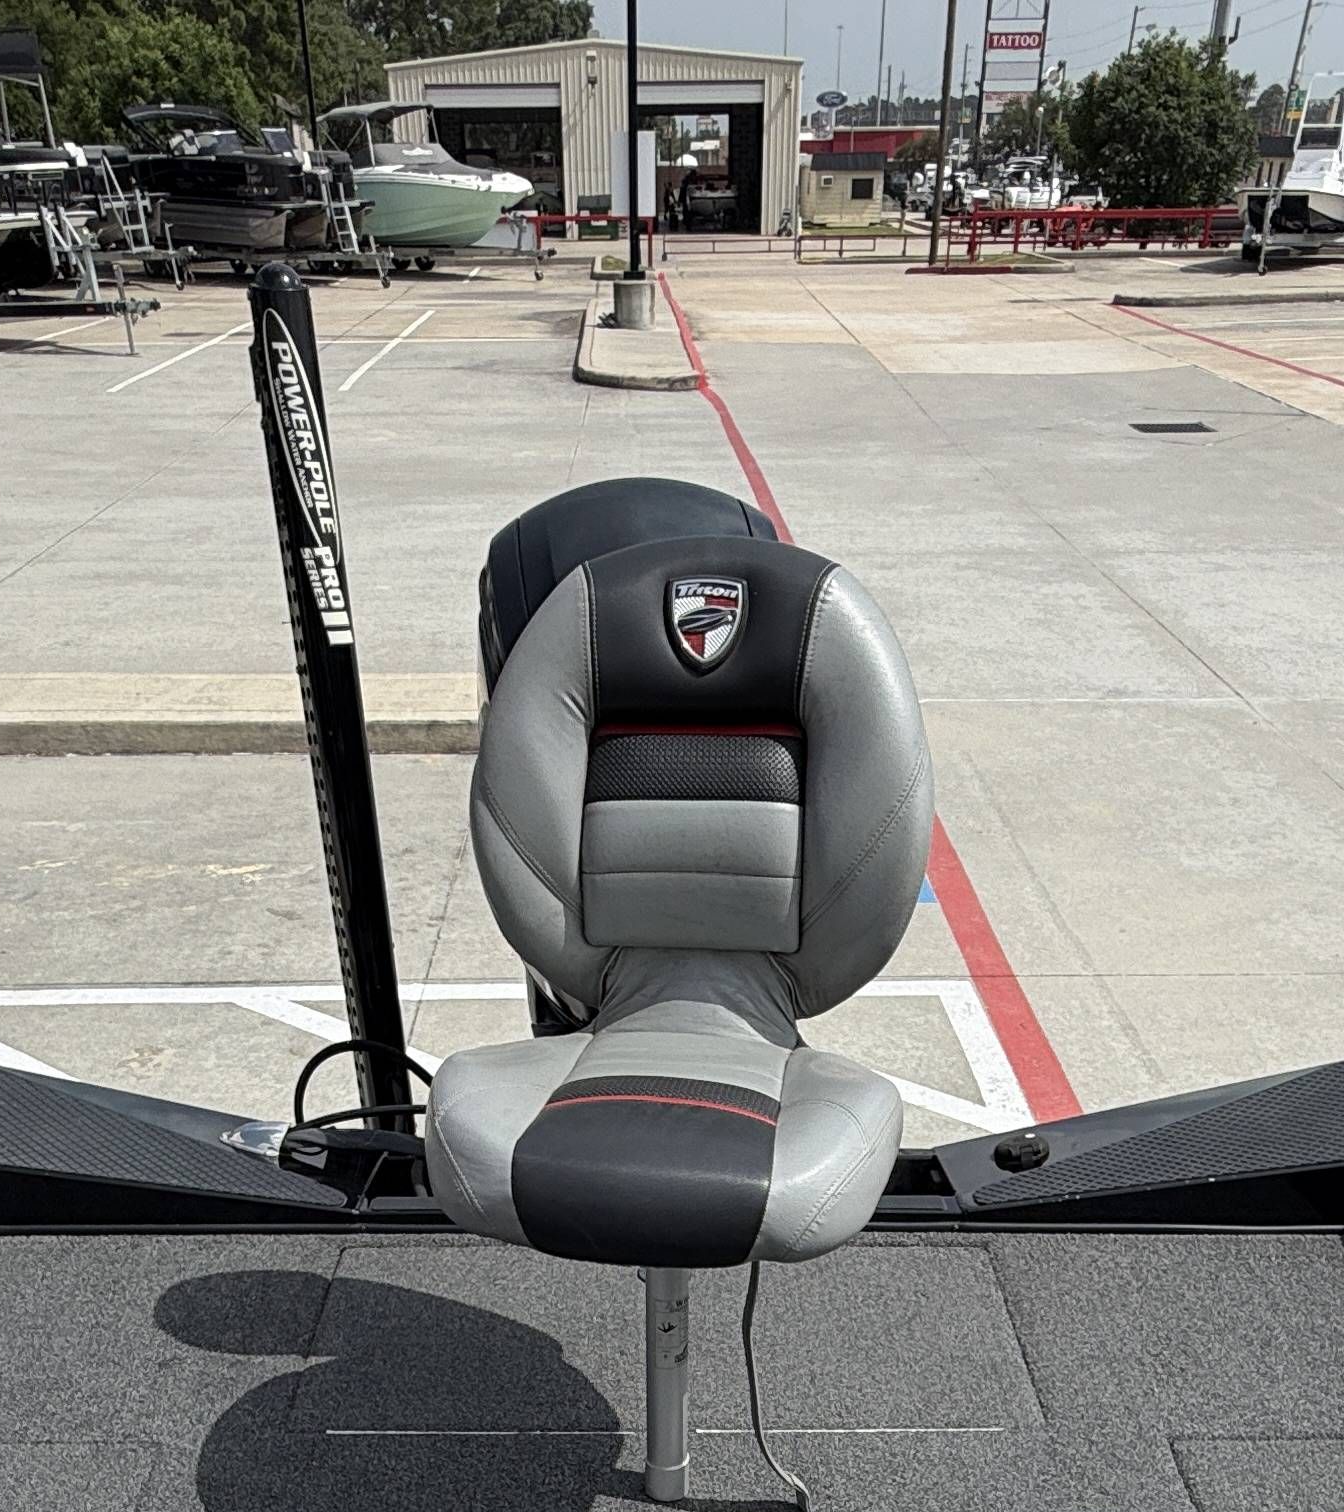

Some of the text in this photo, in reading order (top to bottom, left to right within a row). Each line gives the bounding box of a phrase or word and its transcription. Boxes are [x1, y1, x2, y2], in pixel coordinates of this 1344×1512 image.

[992, 35, 1039, 47] TATTOO
[272, 341, 336, 534] POWER-POLE
[287, 429, 302, 473] WATER
[300, 547, 329, 610] SERIES
[314, 546, 345, 609] PRO
[677, 583, 738, 598] Triton
